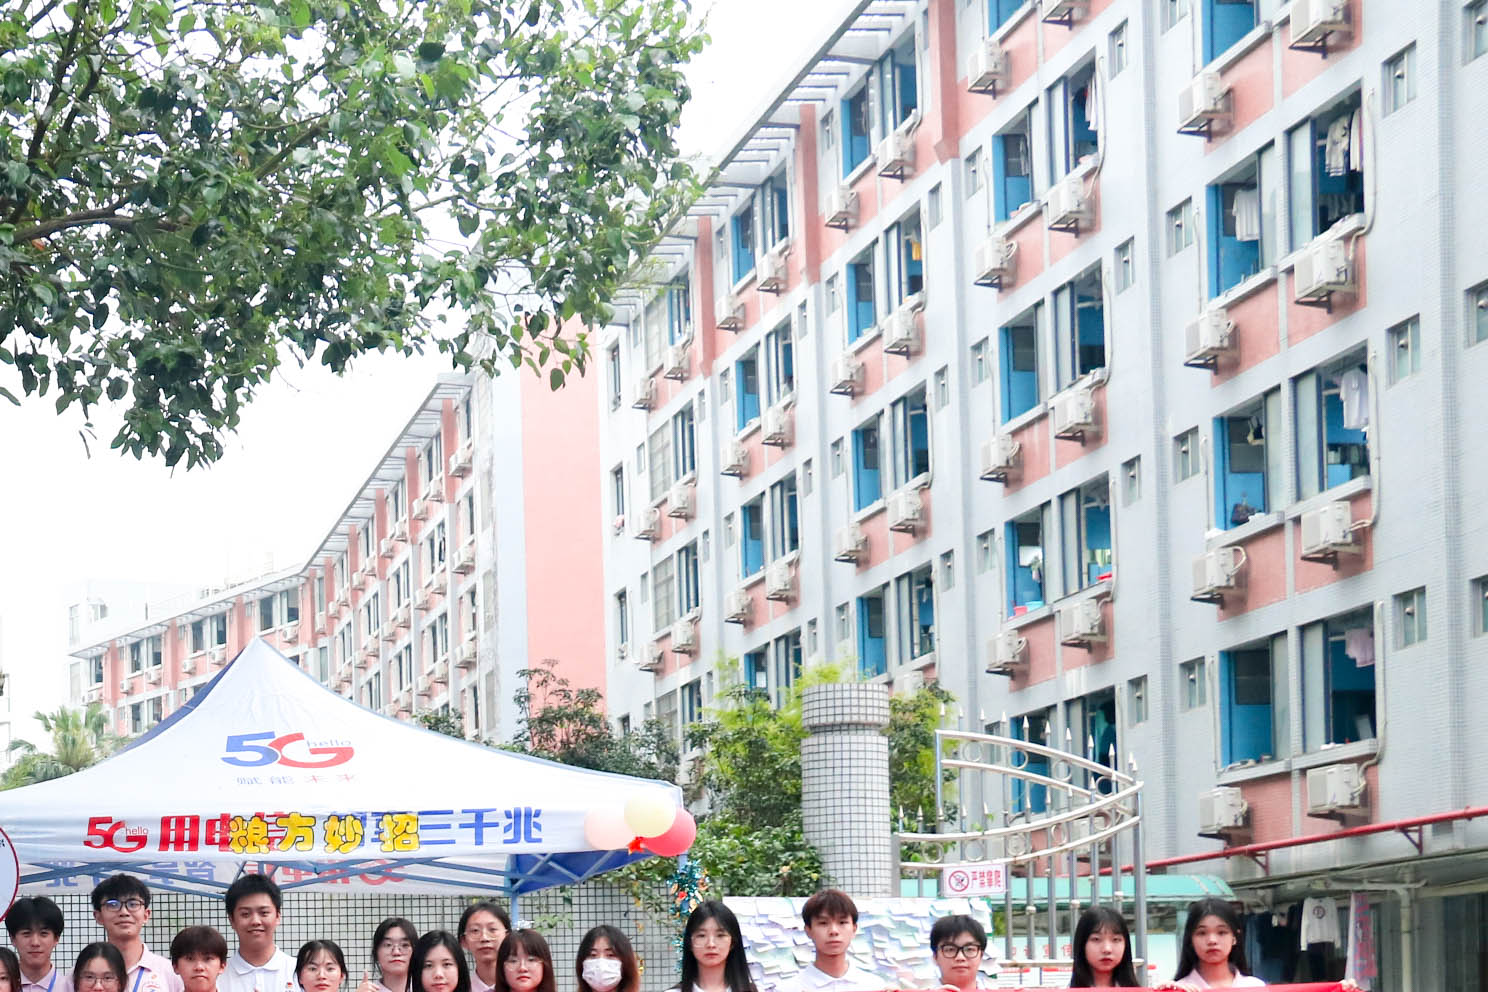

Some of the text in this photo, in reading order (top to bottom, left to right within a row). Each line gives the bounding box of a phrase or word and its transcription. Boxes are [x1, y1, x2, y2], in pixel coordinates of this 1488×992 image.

[221, 731, 355, 768] 5G
[83, 816, 148, 853] 5G
[125, 826, 149, 836] hello
[229, 812, 420, 854] 粮方妙招
